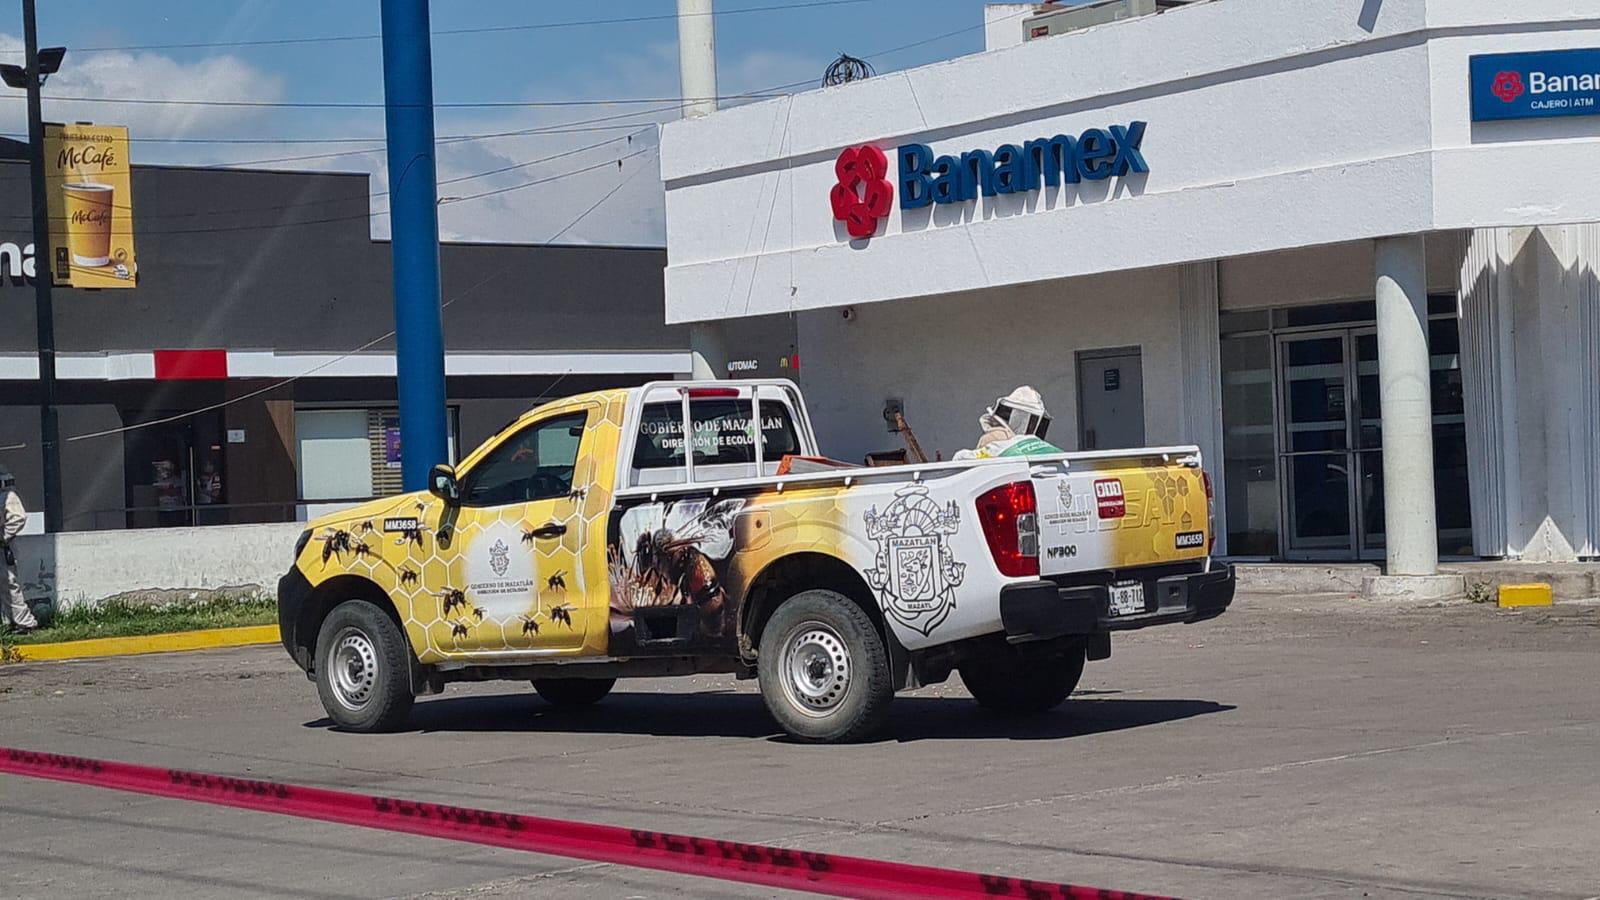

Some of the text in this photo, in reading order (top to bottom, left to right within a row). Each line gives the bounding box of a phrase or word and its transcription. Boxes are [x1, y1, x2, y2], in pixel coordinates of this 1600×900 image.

[1530, 97, 1594, 109] CAJERO ATM
[897, 121, 1150, 209] Banamex
[727, 359, 758, 371] UTOMAC
[640, 415, 783, 435] GOBIERO DE MAZALÁN
[712, 434, 725, 446] DE
[726, 434, 768, 446] ECOLOA
[384, 519, 417, 530] MM3658
[1176, 533, 1203, 546] MM3658
[1047, 544, 1077, 560] NP300
